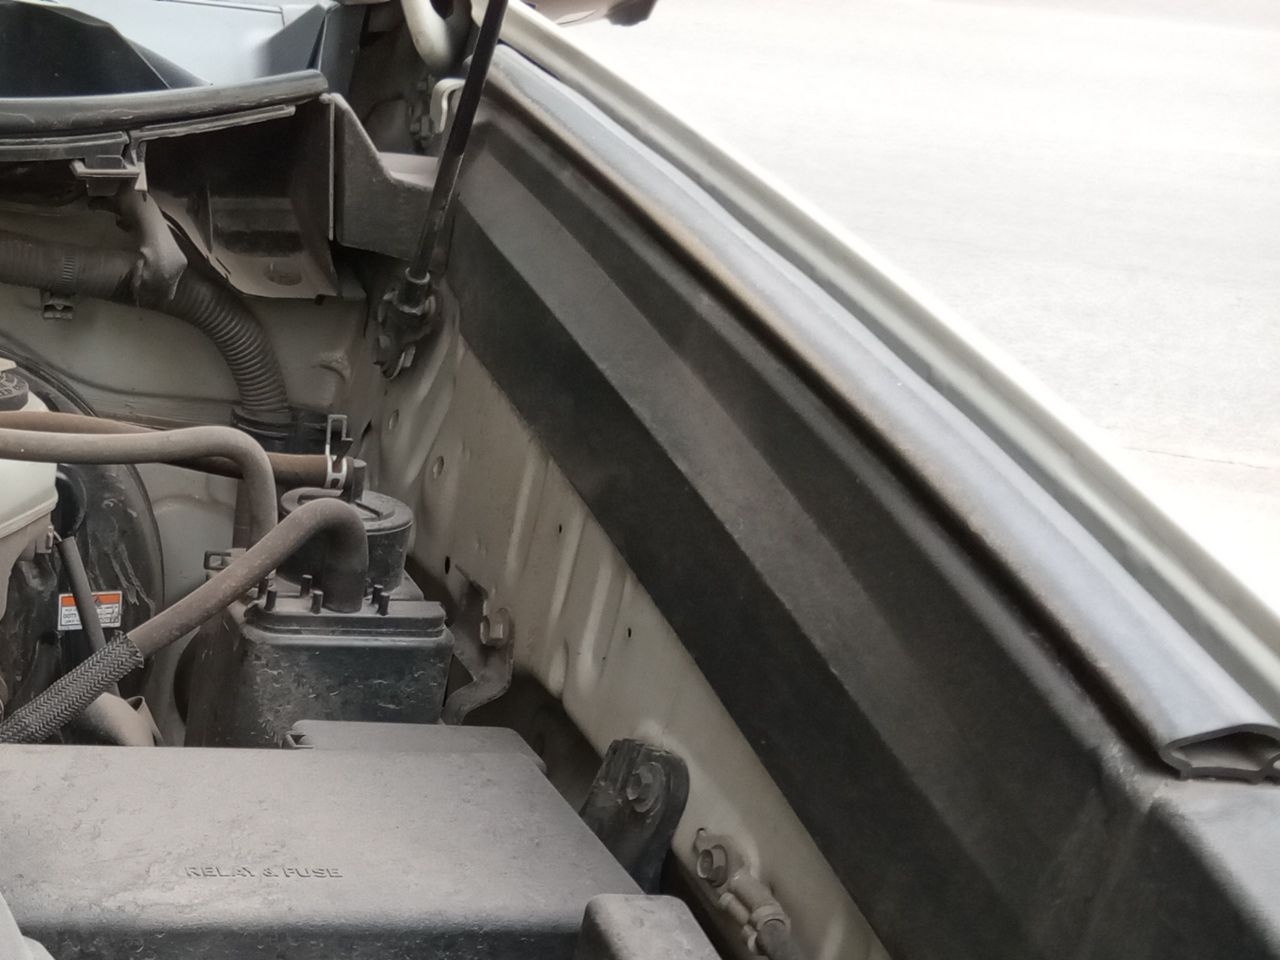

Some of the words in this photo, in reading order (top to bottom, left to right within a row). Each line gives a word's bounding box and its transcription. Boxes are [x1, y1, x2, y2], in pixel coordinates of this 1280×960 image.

[184, 866, 256, 879] RELAY
[262, 866, 278, 878] &
[282, 866, 344, 879] FUSE
